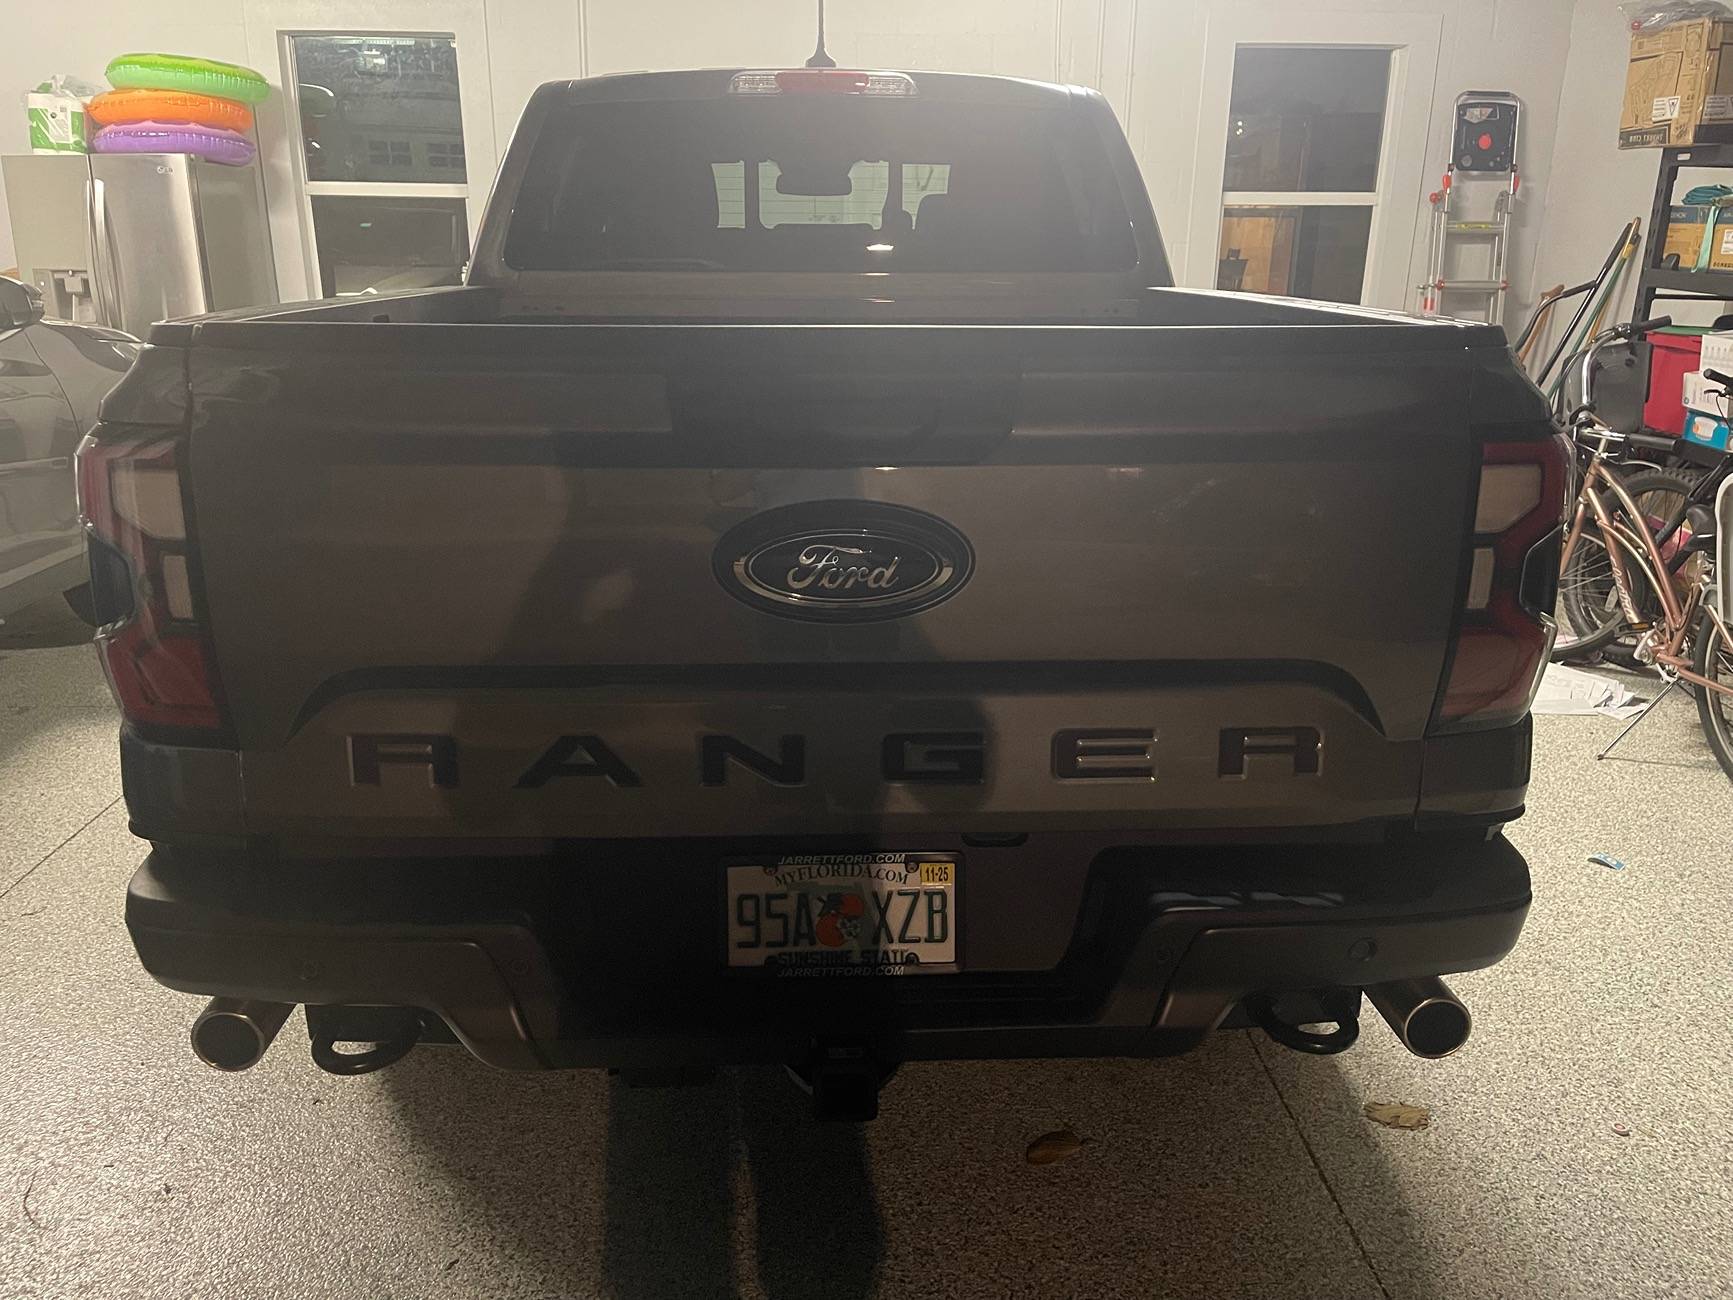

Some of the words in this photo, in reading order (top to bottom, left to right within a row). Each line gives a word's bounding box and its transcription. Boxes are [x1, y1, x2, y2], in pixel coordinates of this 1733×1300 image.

[787, 545, 901, 589] Ford
[346, 727, 1325, 788] RANGER
[777, 853, 906, 865] JARRETTFORD.COM
[774, 863, 909, 887] MYFLORIDA.COM
[925, 866, 949, 882] 11-25
[736, 892, 817, 948] 95A
[872, 888, 949, 944] XZB
[776, 965, 905, 977] JARRETTFORD.COM
